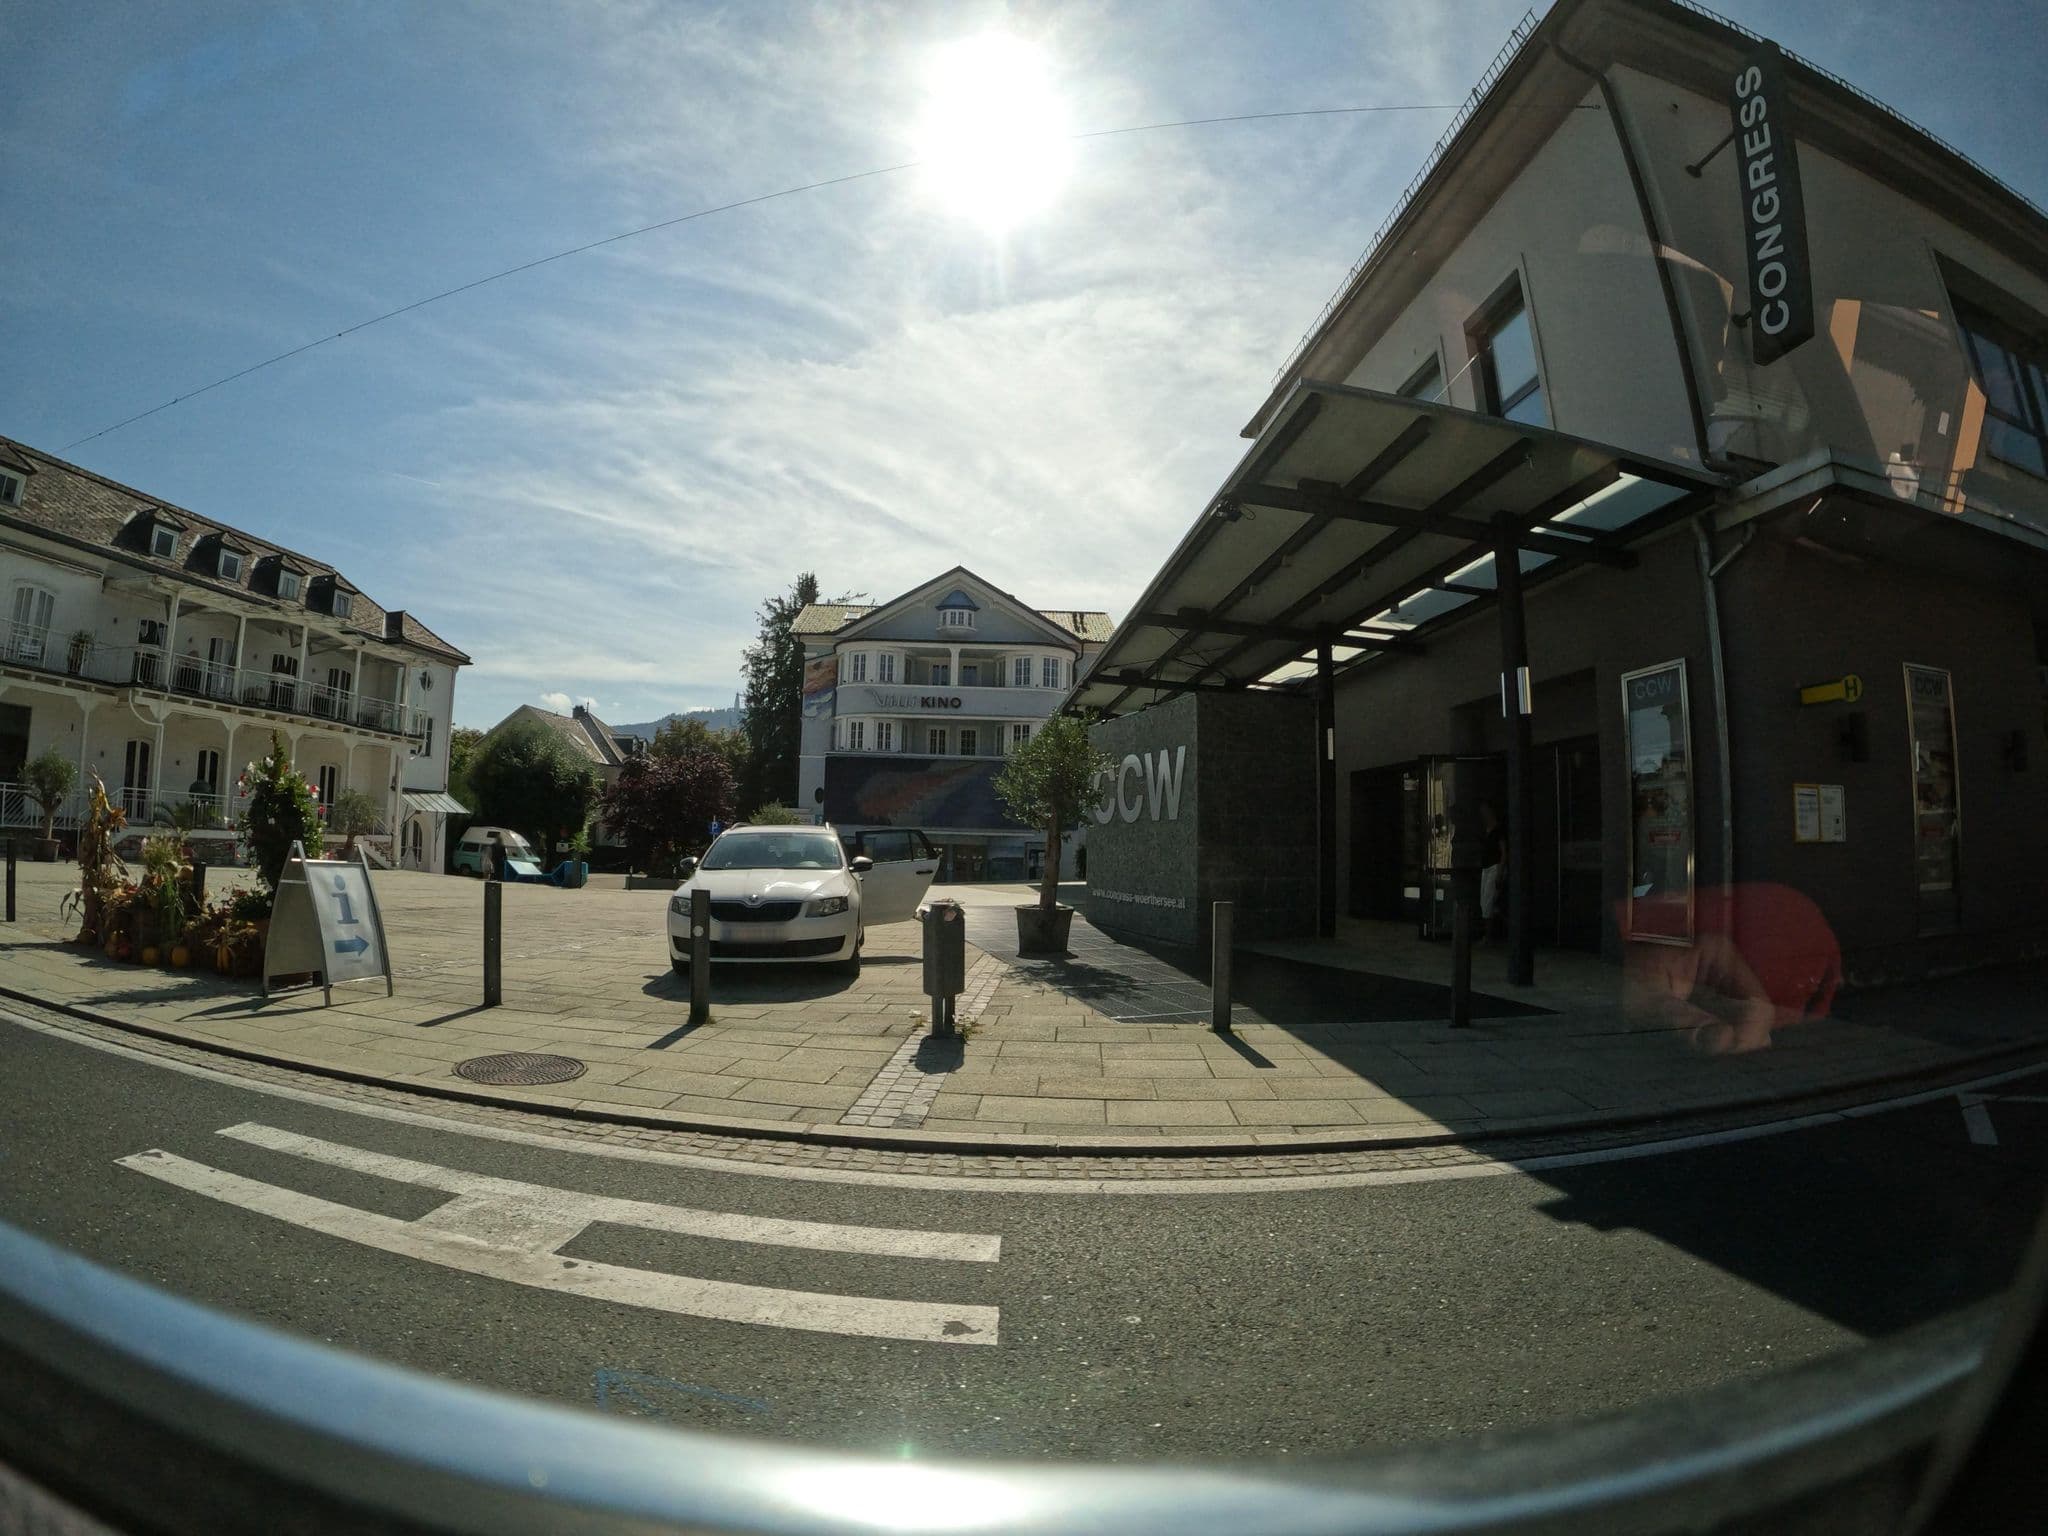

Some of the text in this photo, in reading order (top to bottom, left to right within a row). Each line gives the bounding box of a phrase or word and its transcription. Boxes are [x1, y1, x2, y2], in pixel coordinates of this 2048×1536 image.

[1735, 66, 1790, 335] CONGRESS
[920, 696, 962, 709] KINO
[1635, 674, 1671, 699] CCW
[1844, 676, 1858, 702] H
[1092, 745, 1186, 825] CCW
[331, 874, 360, 924] i
